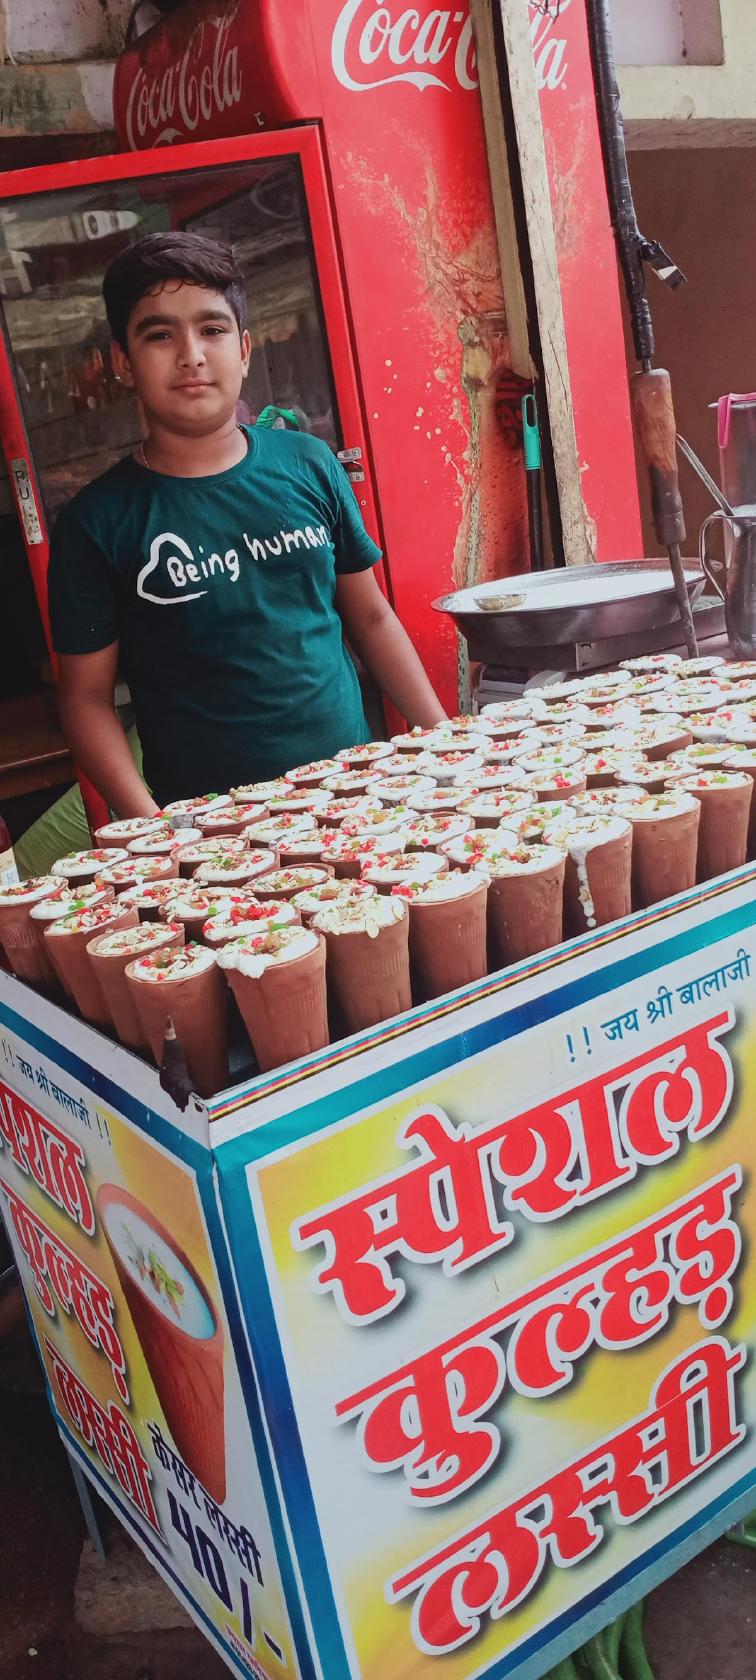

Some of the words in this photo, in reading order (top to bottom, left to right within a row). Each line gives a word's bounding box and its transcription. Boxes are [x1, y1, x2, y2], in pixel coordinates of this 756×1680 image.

[167, 546, 240, 587] Being
[243, 526, 331, 561] human
[600, 1008, 639, 1041] जय
[646, 985, 673, 1024] श्री
[676, 948, 751, 1005] बालाजी
[16, 1054, 34, 1083] जय
[49, 1080, 91, 1130] बालाजी
[300, 1010, 730, 1317] स्पेशल
[43, 1333, 164, 1542] लस्सी
[199, 1480, 264, 1588] लस्सी
[391, 1343, 743, 1649] लस्सी
